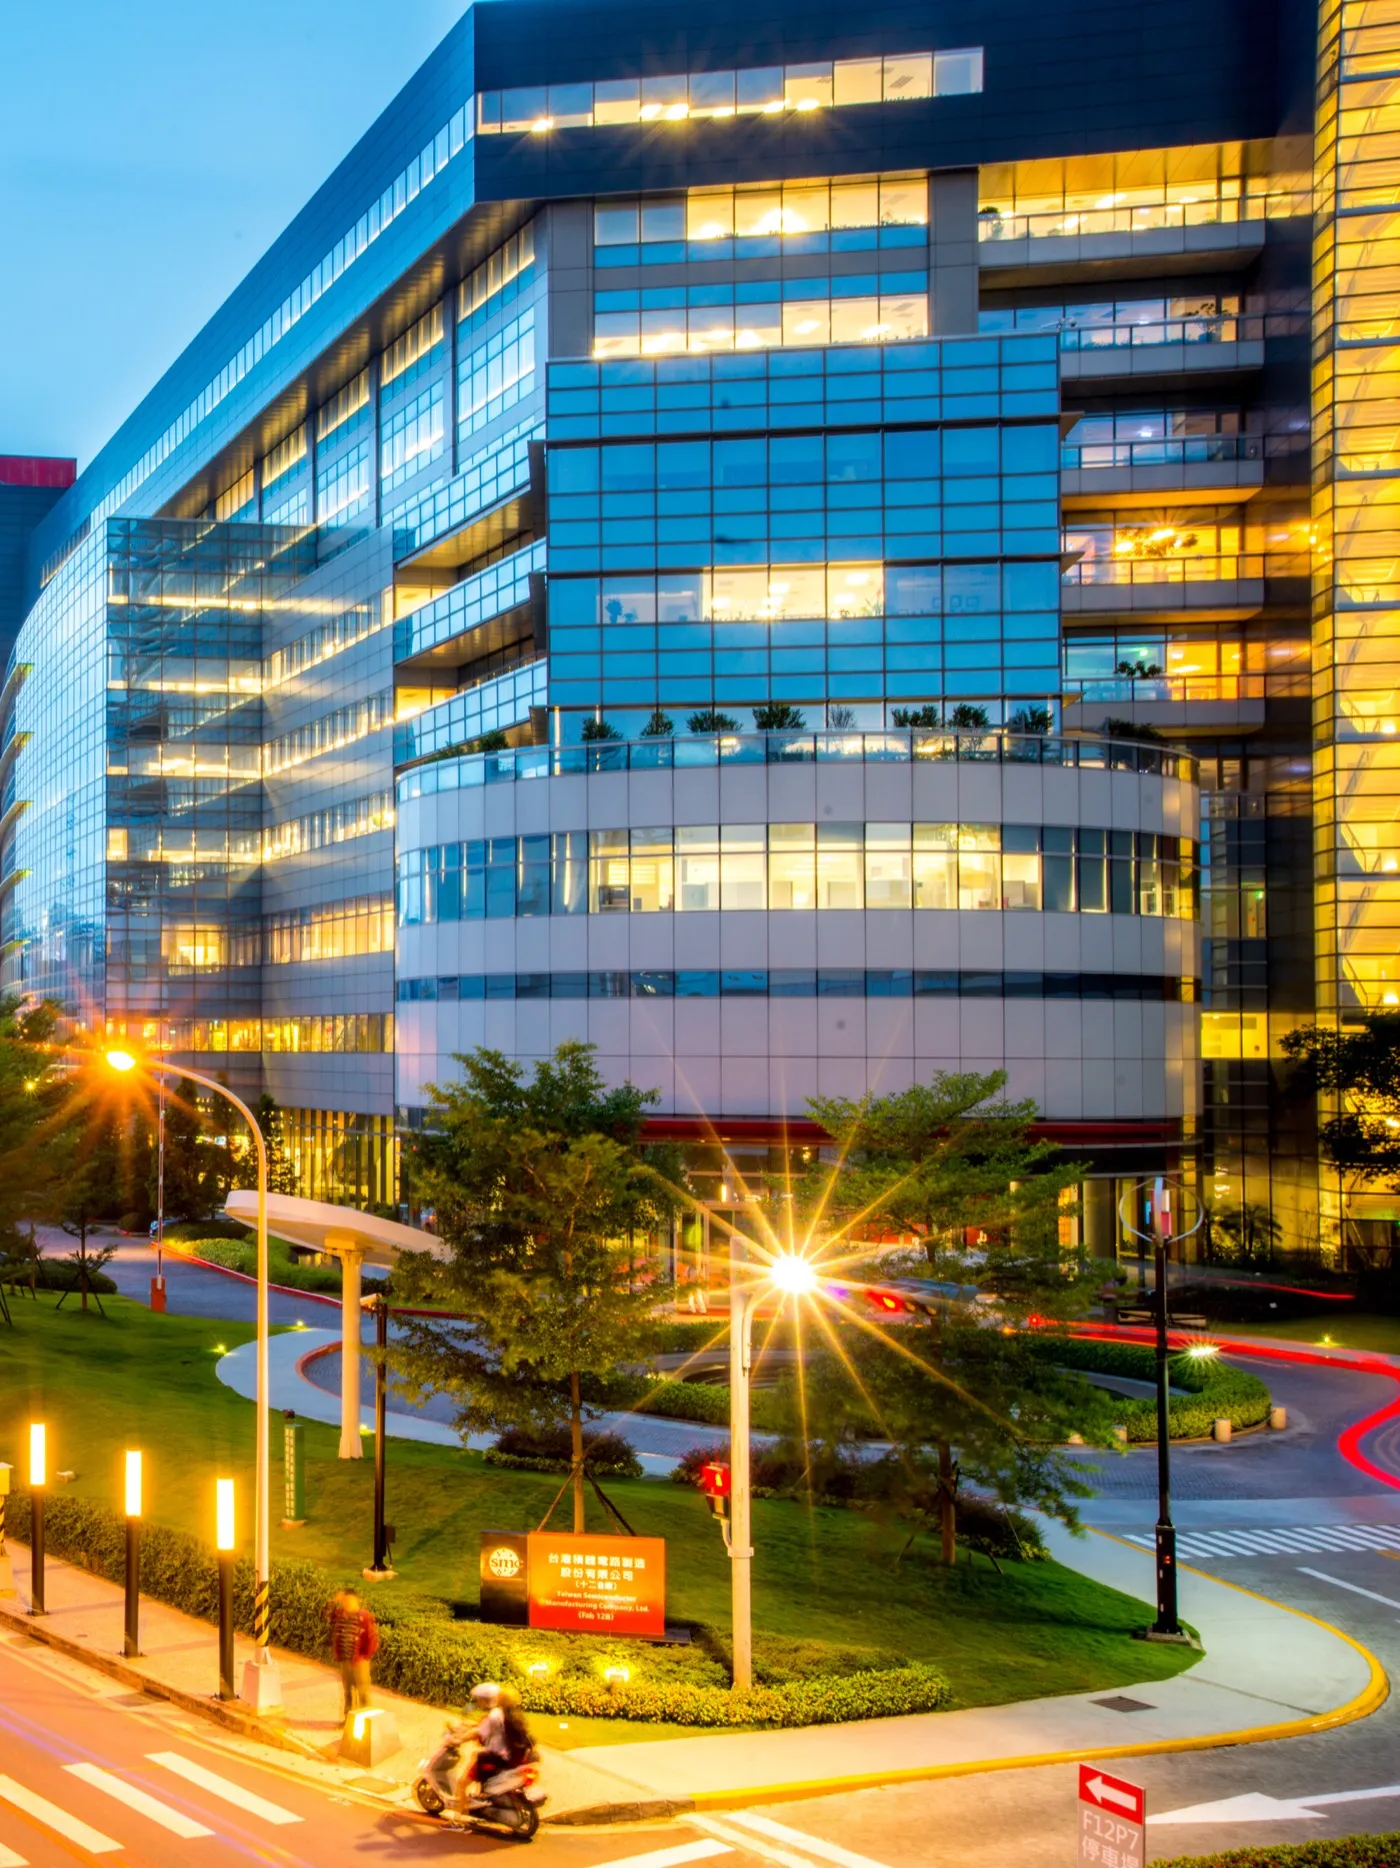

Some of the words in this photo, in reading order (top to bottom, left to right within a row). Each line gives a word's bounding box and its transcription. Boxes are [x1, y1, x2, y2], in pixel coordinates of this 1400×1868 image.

[560, 1567, 633, 1582] 股份有限公司
[557, 1590, 582, 1598] Taiwan
[583, 1591, 636, 1602] Semiconductor
[545, 1599, 598, 1609] Manufacturing
[1083, 1809, 1139, 1850] F12P7
